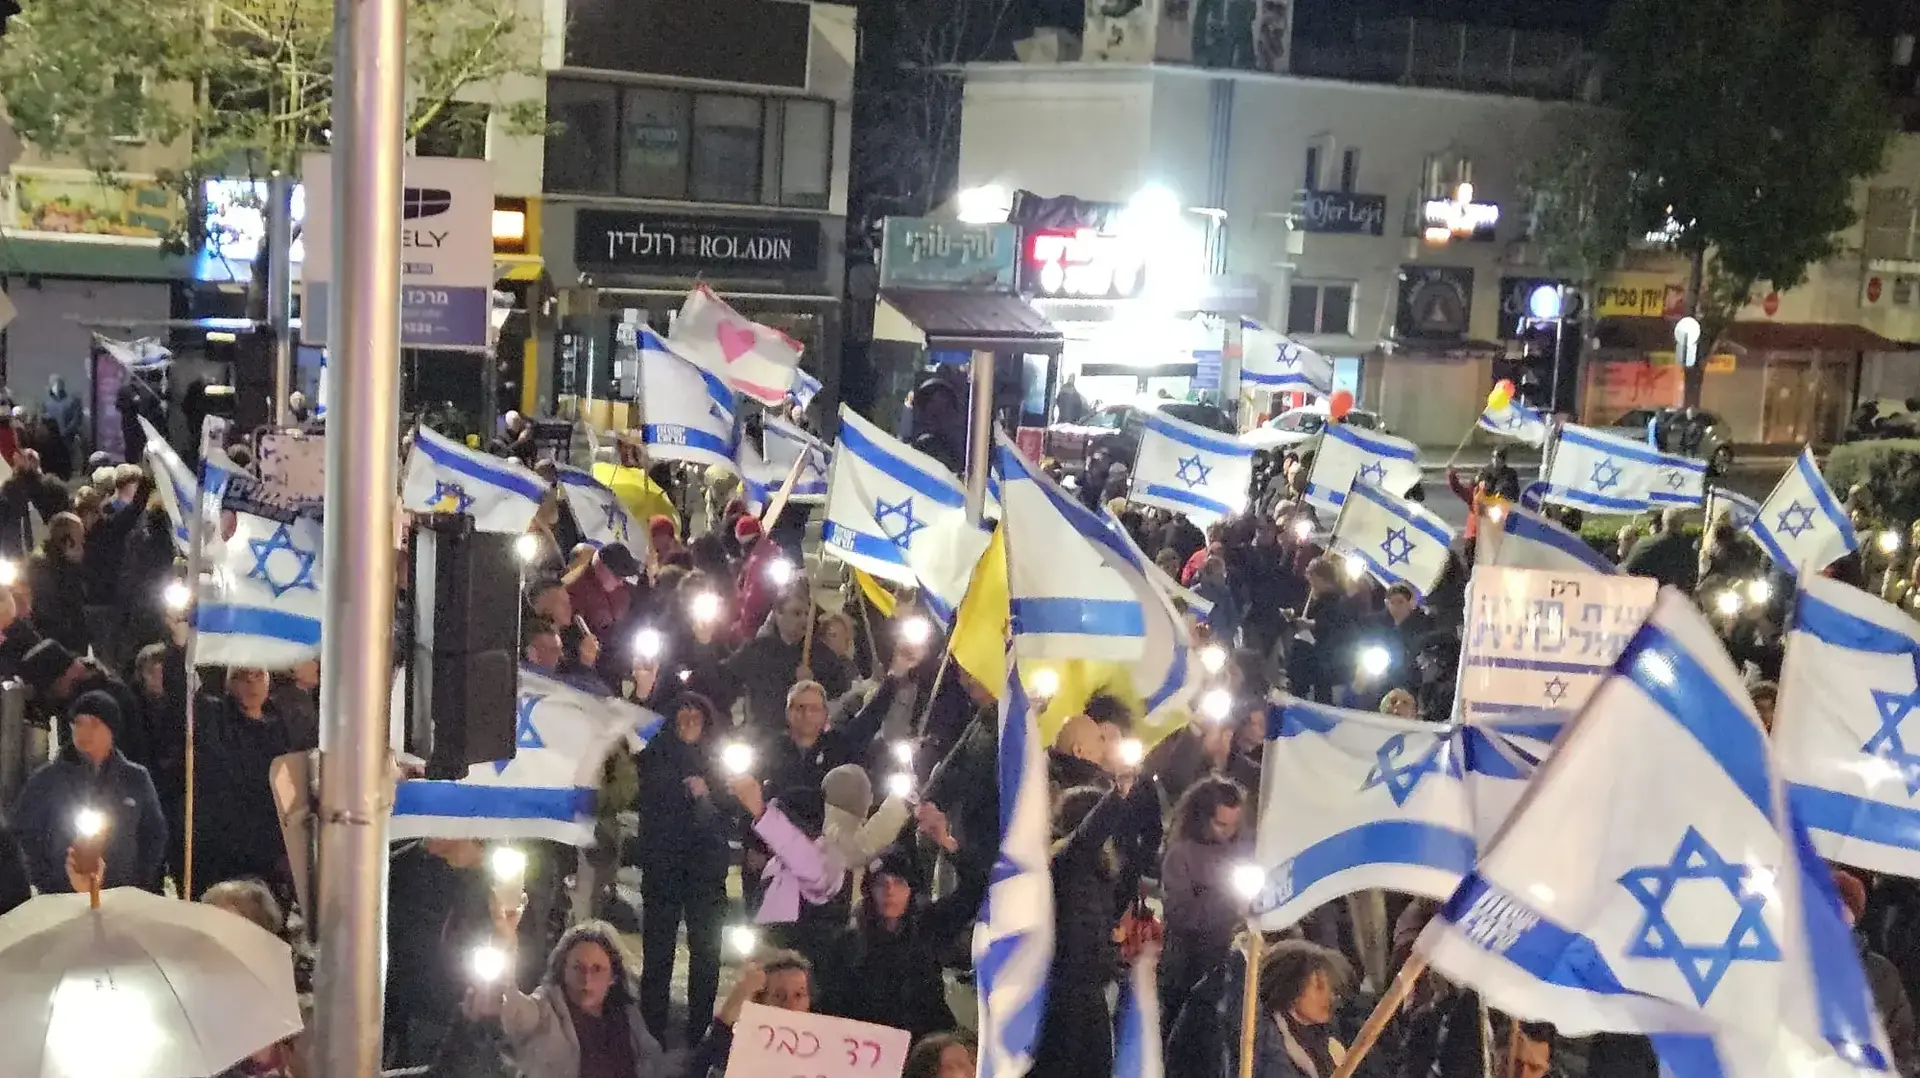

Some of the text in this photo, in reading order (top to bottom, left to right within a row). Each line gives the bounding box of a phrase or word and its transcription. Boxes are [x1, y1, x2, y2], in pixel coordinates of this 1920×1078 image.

[1311, 195, 1347, 226] Ofer
[403, 230, 449, 248] ELY
[607, 223, 675, 260] רולדין
[700, 235, 791, 260] ROLADIN
[408, 289, 449, 305] מרכז
[1550, 579, 1581, 598] רק
[758, 1024, 820, 1058] כבר
